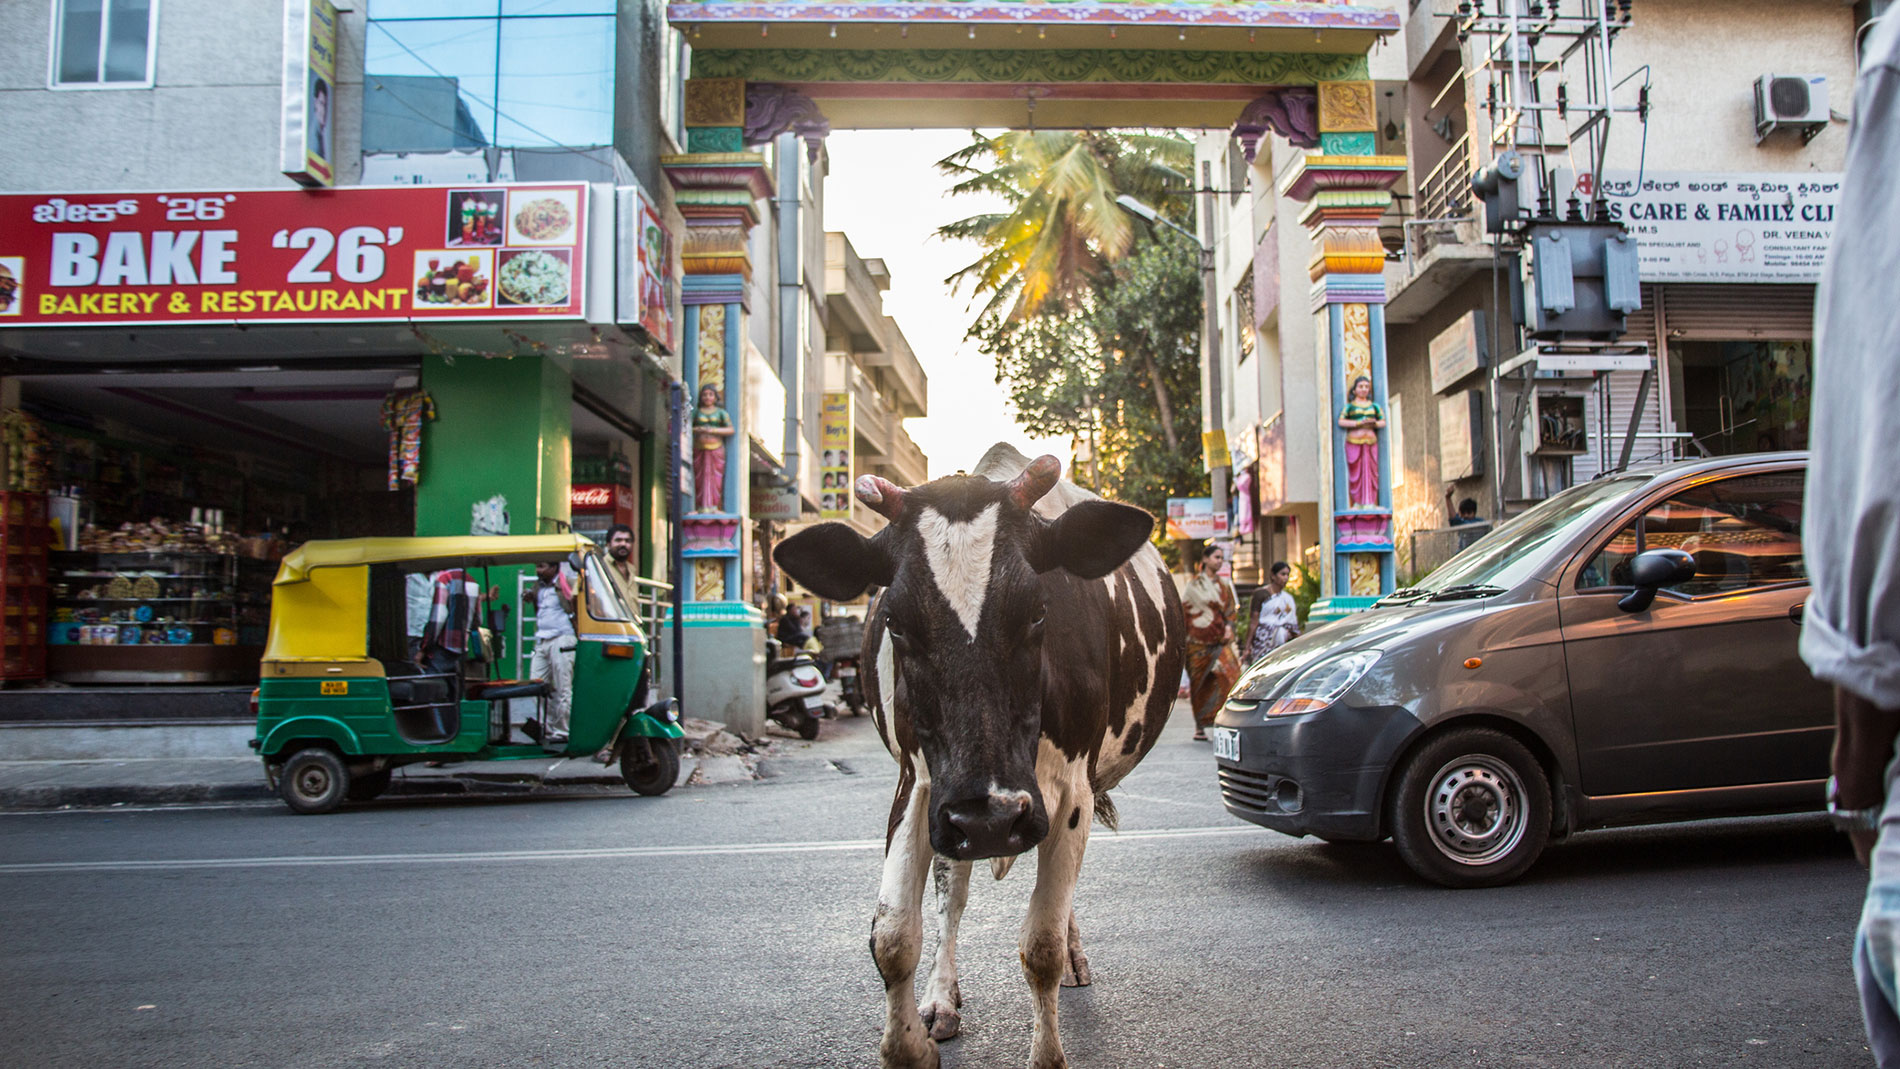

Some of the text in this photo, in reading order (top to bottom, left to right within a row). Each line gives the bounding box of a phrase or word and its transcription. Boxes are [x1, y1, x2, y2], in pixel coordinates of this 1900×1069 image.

[1630, 203, 1687, 220] CARE
[1694, 203, 1711, 221] &
[1717, 203, 1795, 221] FAMILY
[1801, 204, 1836, 222] CLI
[1763, 231, 1782, 239] DR.
[1785, 231, 1823, 239] VEENA
[49, 230, 239, 287] BAKE
[38, 288, 409, 315] BAKERY & RESTAURANT
